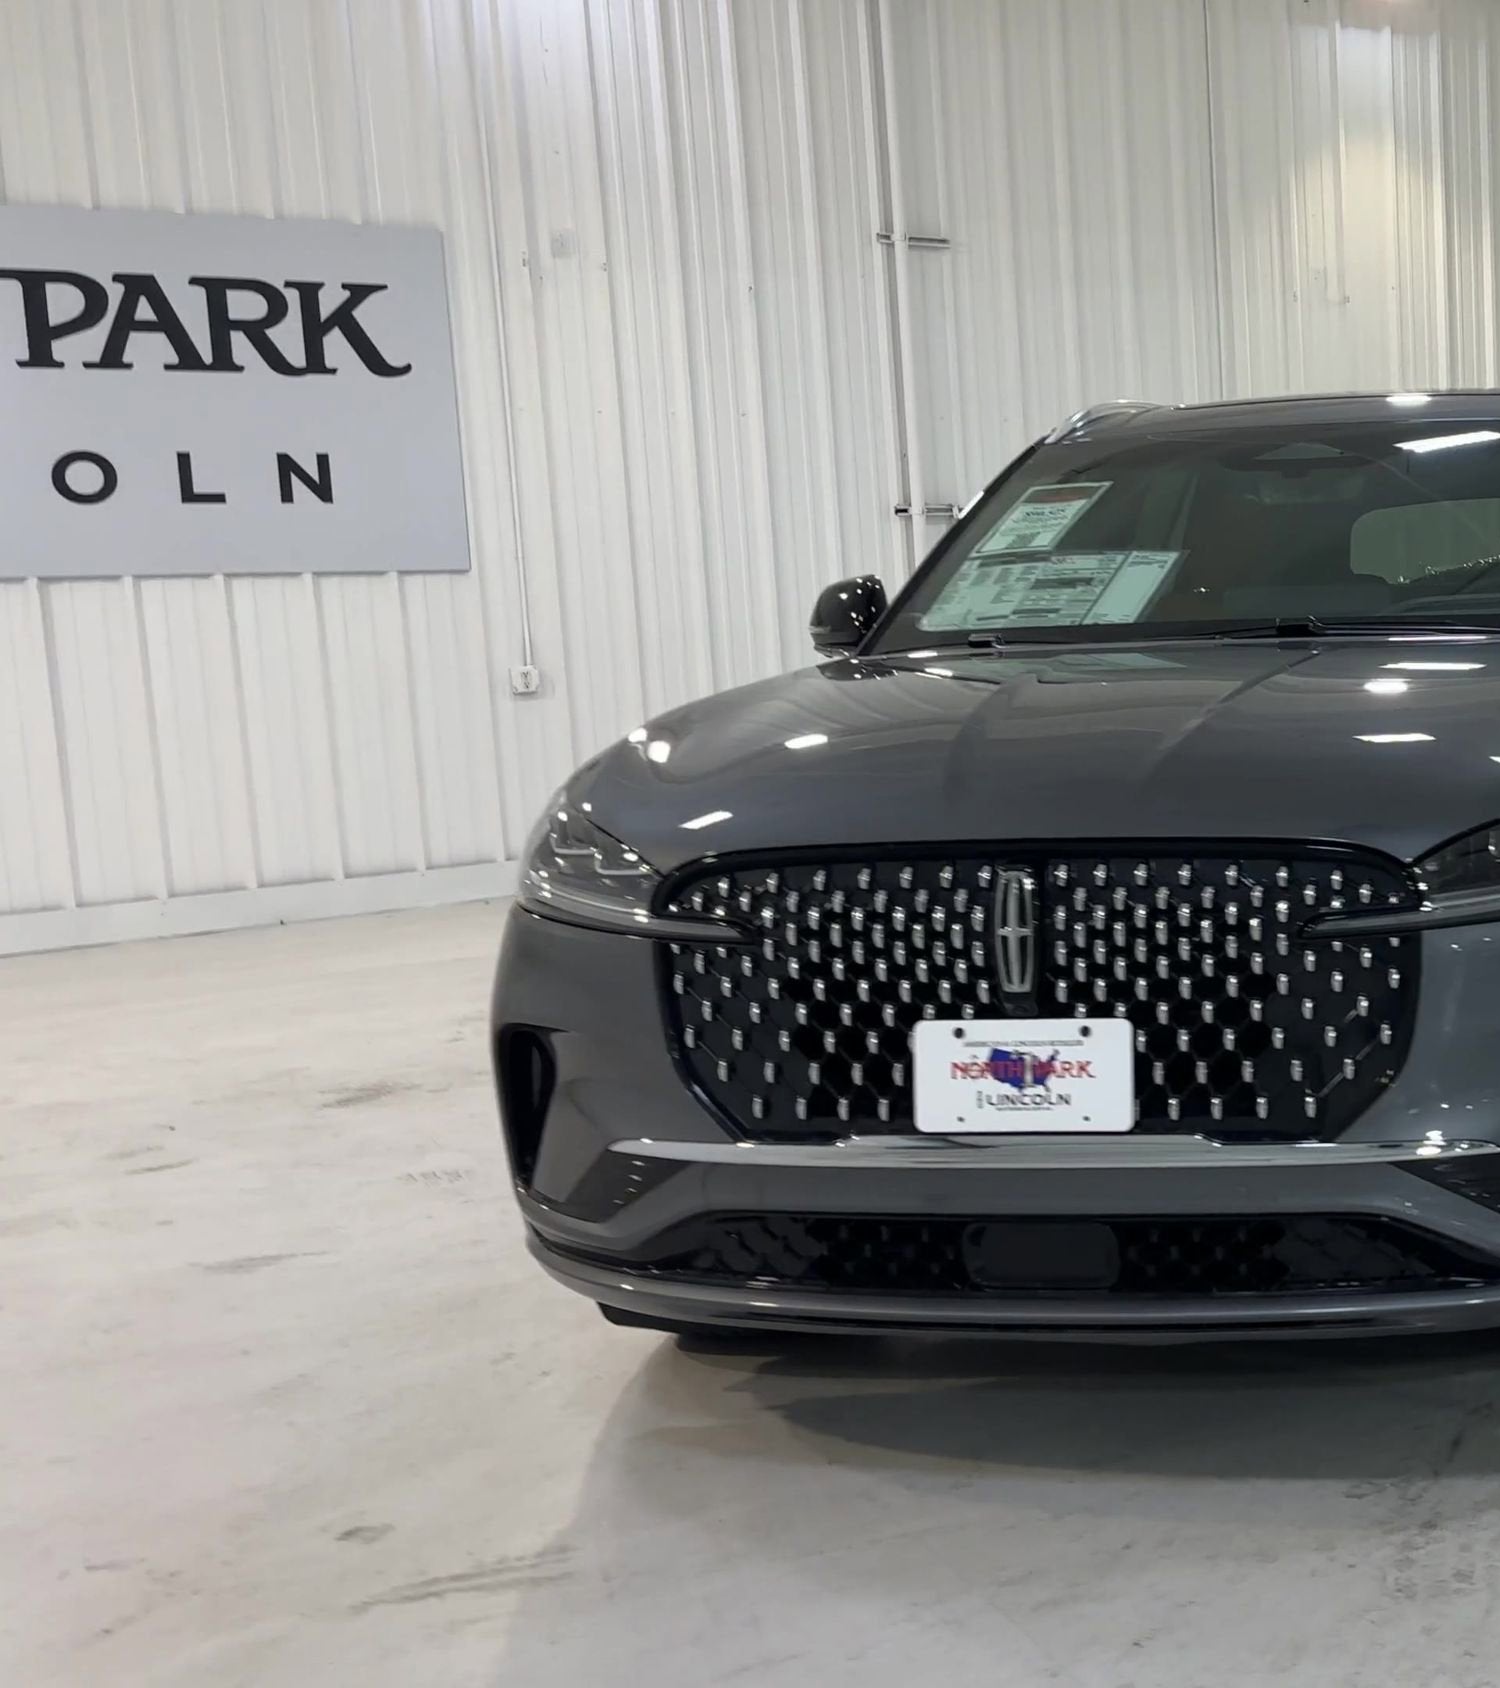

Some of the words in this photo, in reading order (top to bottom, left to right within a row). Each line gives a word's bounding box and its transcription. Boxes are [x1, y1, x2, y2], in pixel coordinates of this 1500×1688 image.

[0, 269, 412, 377] PARK
[950, 1060, 1023, 1080] NORTH
[985, 1093, 1072, 1106] LINCOLN
